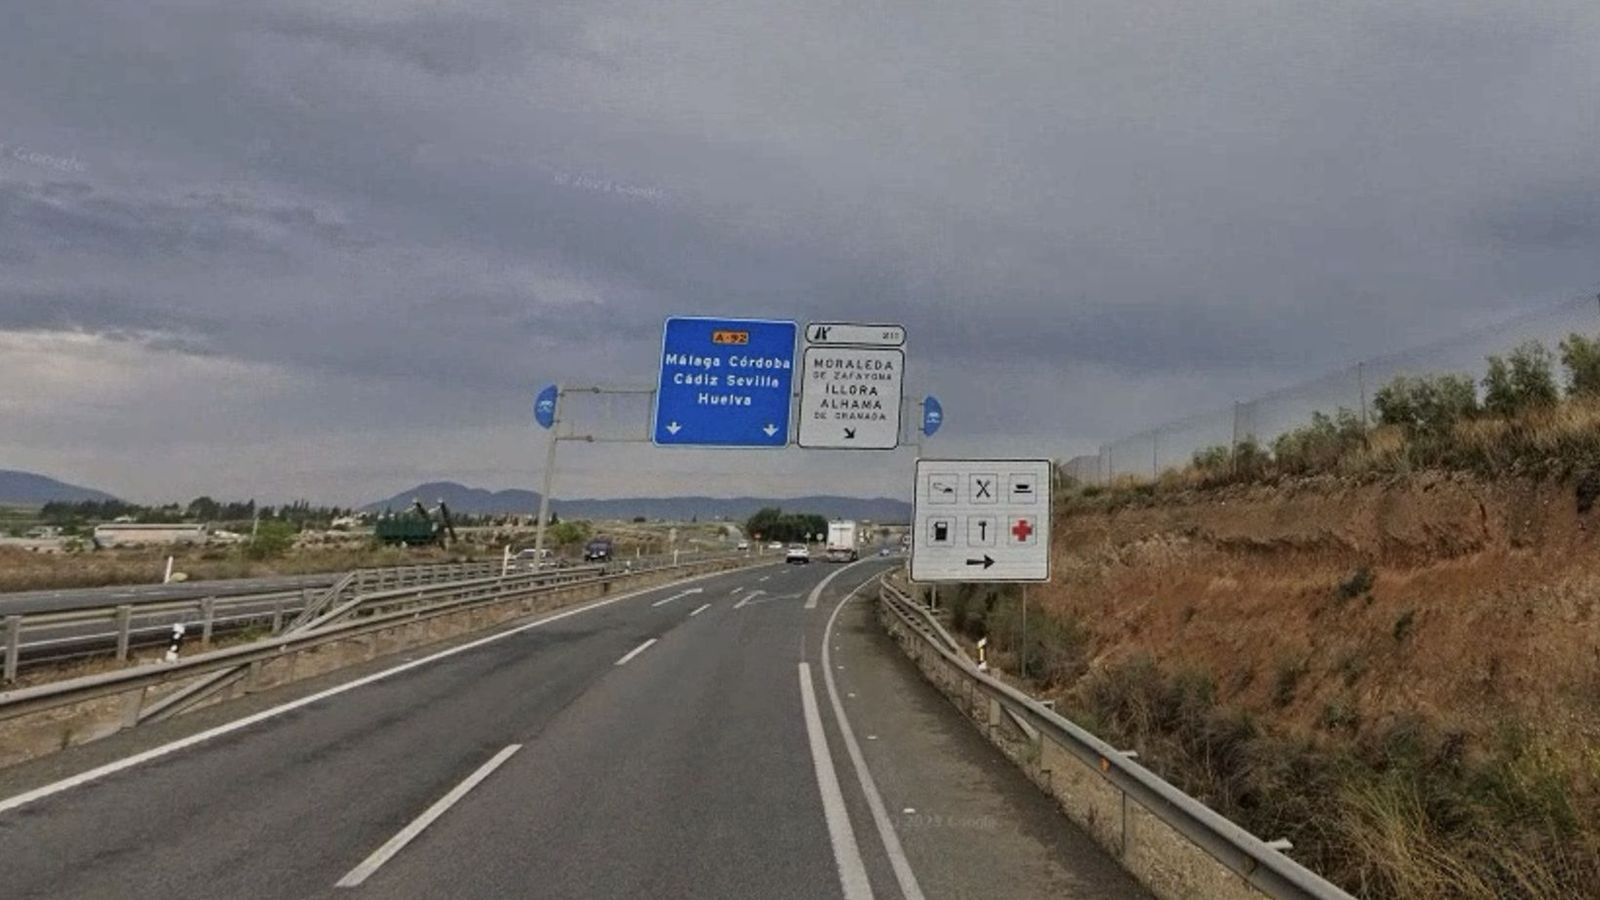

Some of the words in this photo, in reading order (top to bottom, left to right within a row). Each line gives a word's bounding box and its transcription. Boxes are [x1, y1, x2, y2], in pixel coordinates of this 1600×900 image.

[715, 333, 747, 343] A-92
[665, 354, 721, 369] Málaga
[728, 356, 791, 369] Córdoba
[814, 358, 893, 370] MORALEDA
[674, 373, 719, 386] Cádiz
[727, 375, 779, 388] Sevilla
[813, 371, 826, 379] DE
[698, 393, 752, 406] Huelva
[820, 398, 882, 410] ALHAMA
[834, 412, 886, 420] GRANADA
